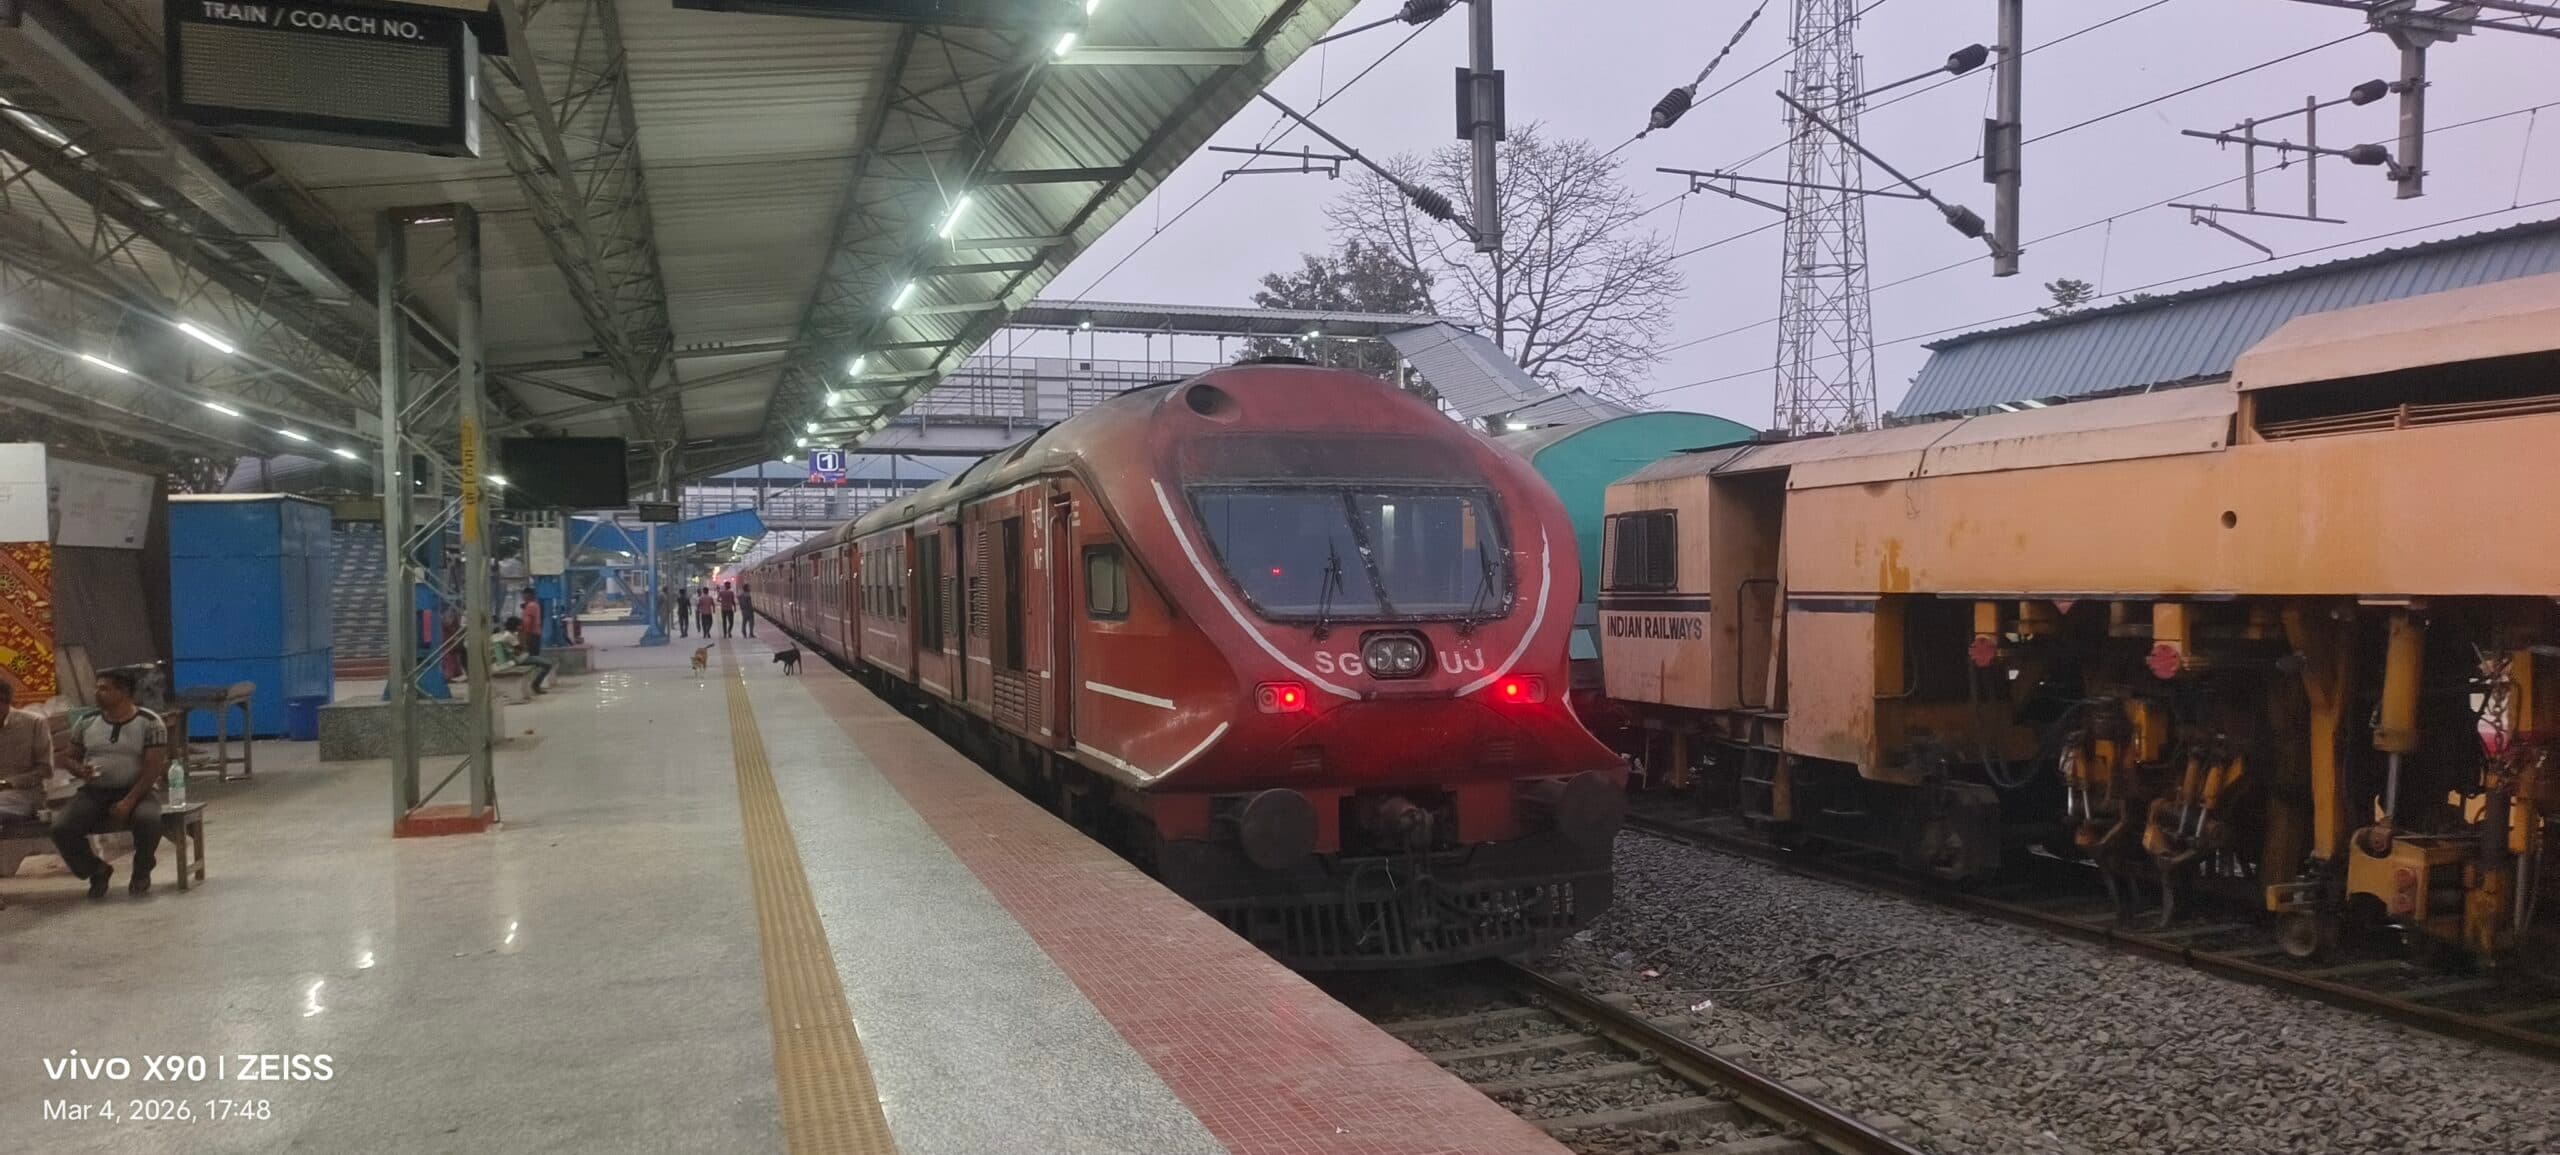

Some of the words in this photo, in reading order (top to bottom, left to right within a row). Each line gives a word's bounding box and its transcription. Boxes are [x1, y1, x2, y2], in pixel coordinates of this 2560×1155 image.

[203, 0, 267, 24] TRAIN
[272, 8, 285, 27] /
[289, 10, 376, 34] COACH
[382, 20, 425, 40] NO.
[1607, 615, 1642, 639] INDIAN
[1644, 616, 1703, 641] RAILWAYS
[1313, 650, 1364, 677] SG
[1439, 648, 1486, 675] UJ
